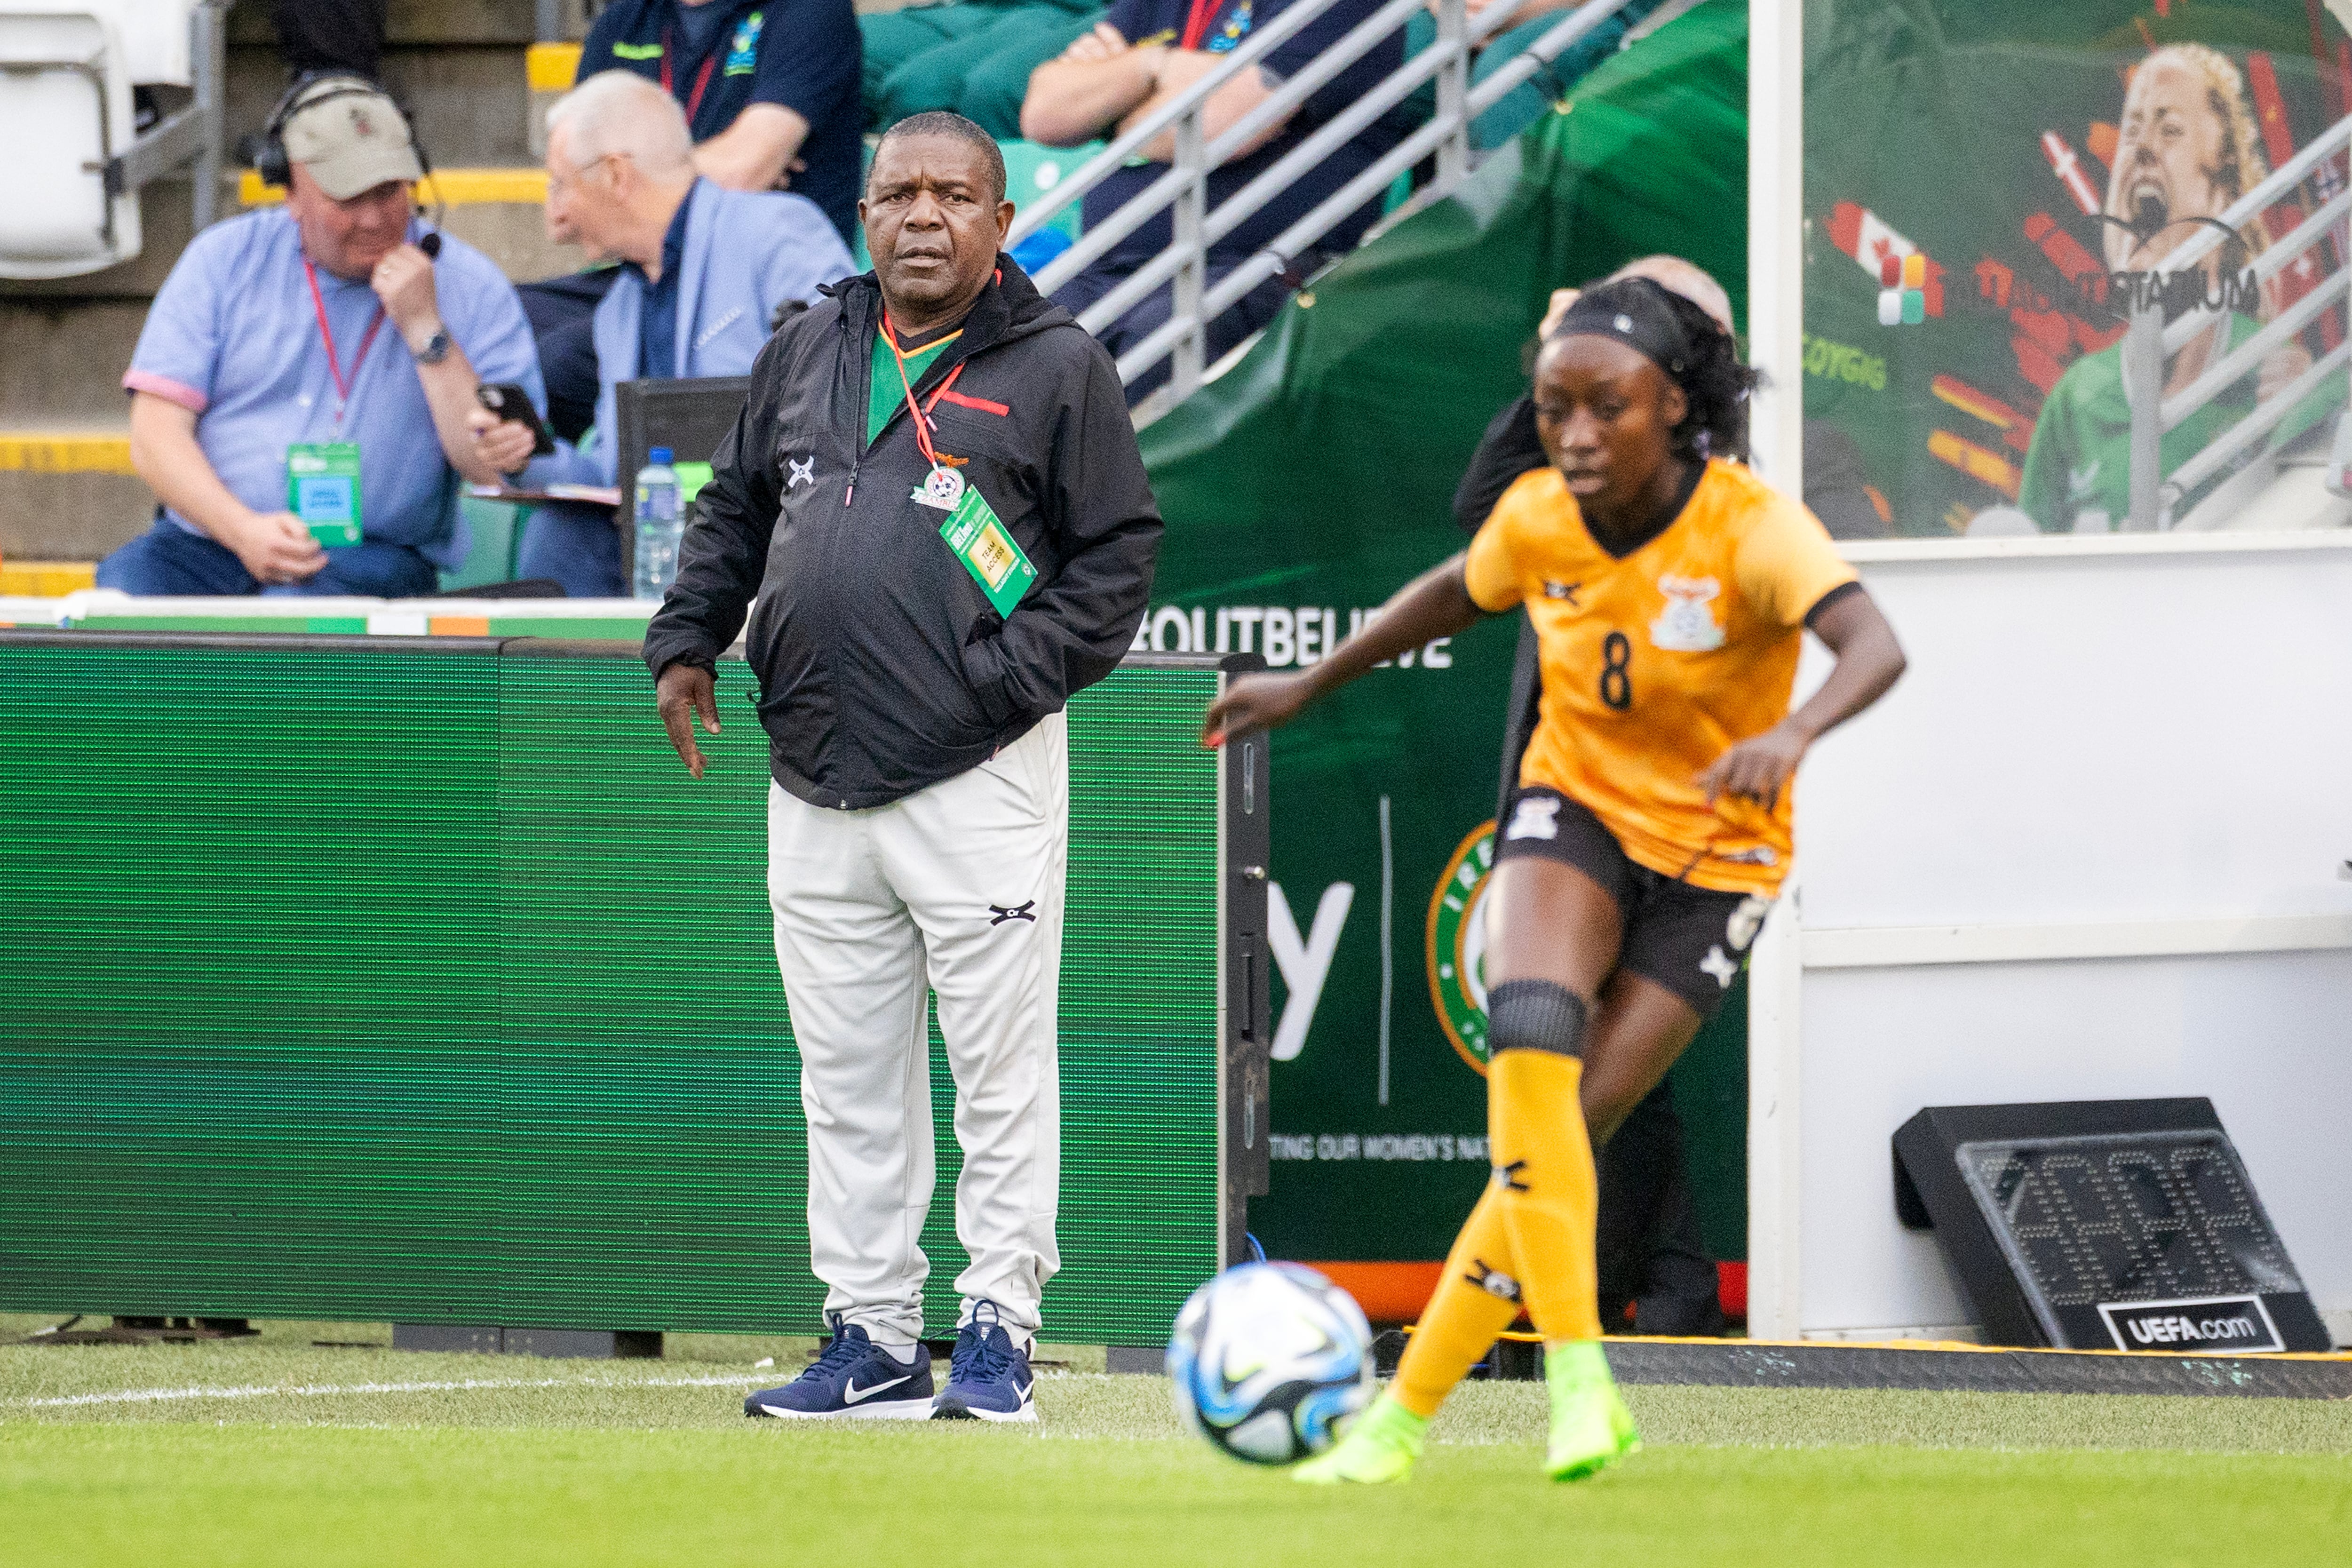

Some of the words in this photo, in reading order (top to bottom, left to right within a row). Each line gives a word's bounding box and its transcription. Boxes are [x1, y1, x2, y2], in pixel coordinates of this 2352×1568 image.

[981, 540, 997, 560] TEAM
[985, 545, 1005, 573] ACCESS
[1600, 630, 1631, 711] 8
[1268, 1134, 1315, 1160] TING
[1317, 1134, 1361, 1160] OUR
[1362, 1134, 1455, 1160] WOMEN'S
[2126, 1315, 2256, 1344] UEFA.com
